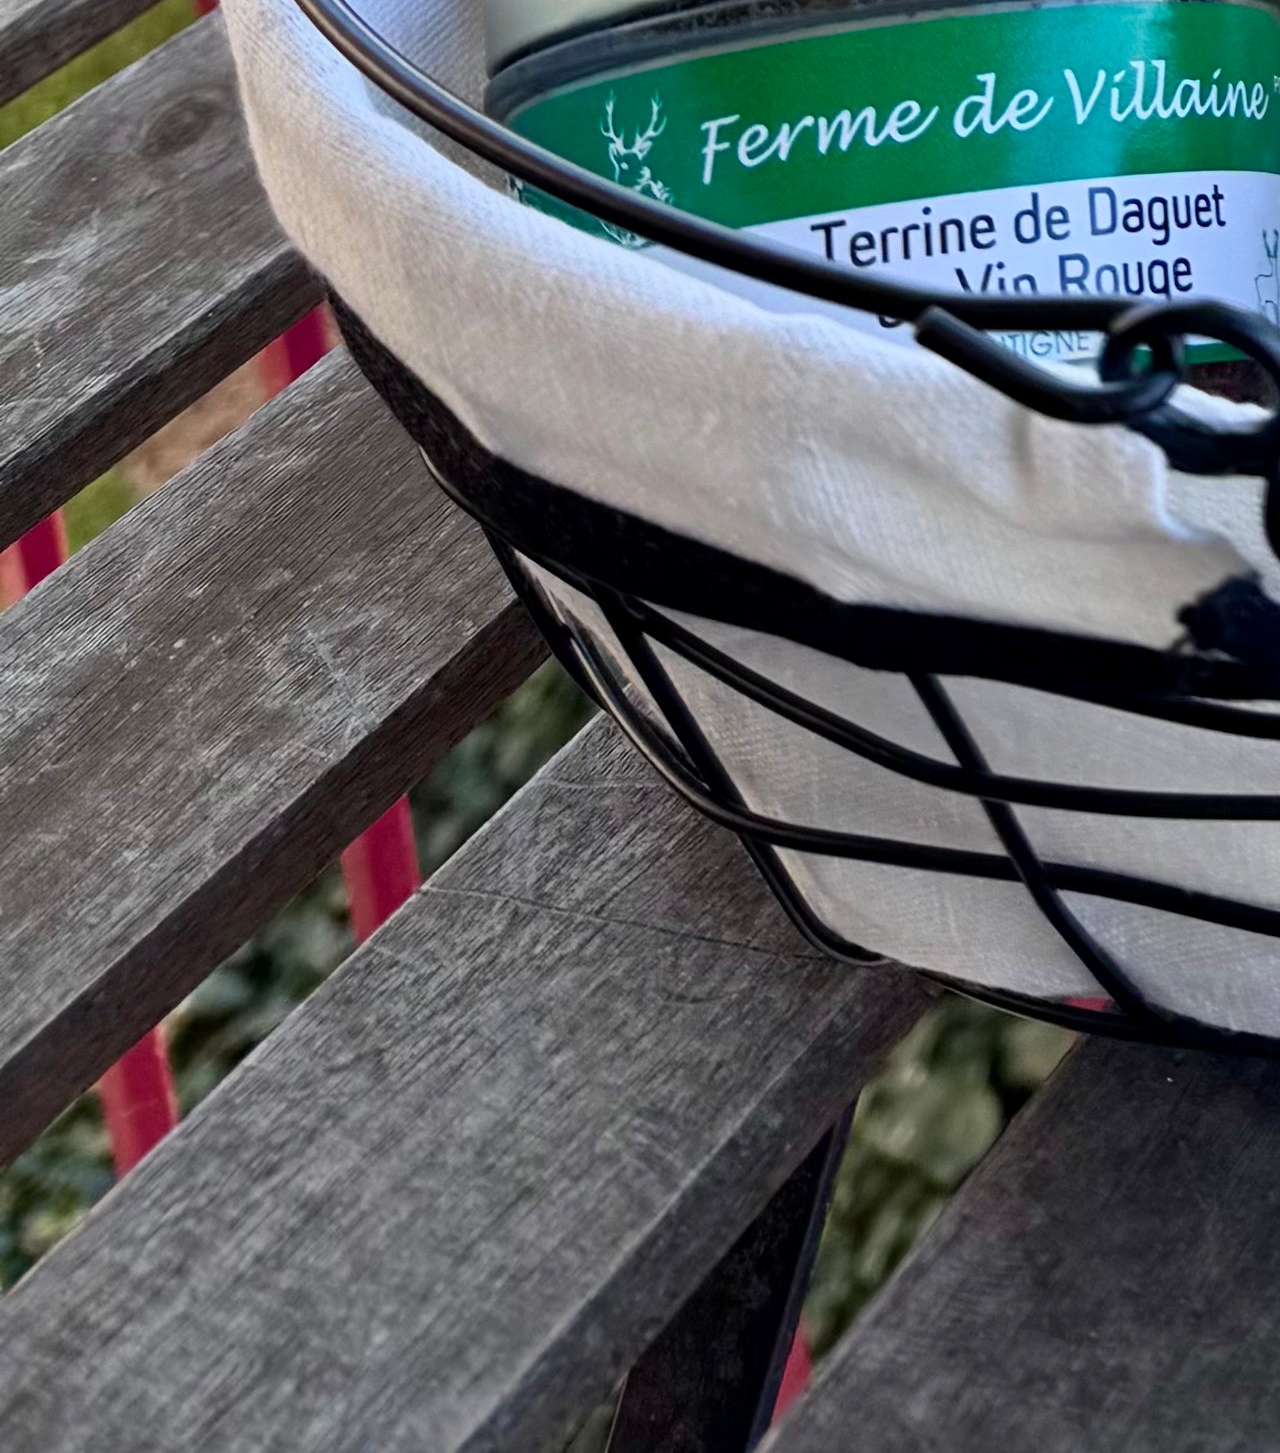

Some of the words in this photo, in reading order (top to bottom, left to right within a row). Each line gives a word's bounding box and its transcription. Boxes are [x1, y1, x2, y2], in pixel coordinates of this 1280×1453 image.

[700, 99, 938, 185] Ferme
[953, 73, 1054, 139] de
[1063, 59, 1269, 125] Villaine
[810, 207, 997, 267] Terrine
[1014, 192, 1071, 245] de
[1088, 184, 1226, 246] Daguet
[1058, 252, 1194, 301] Rouge
